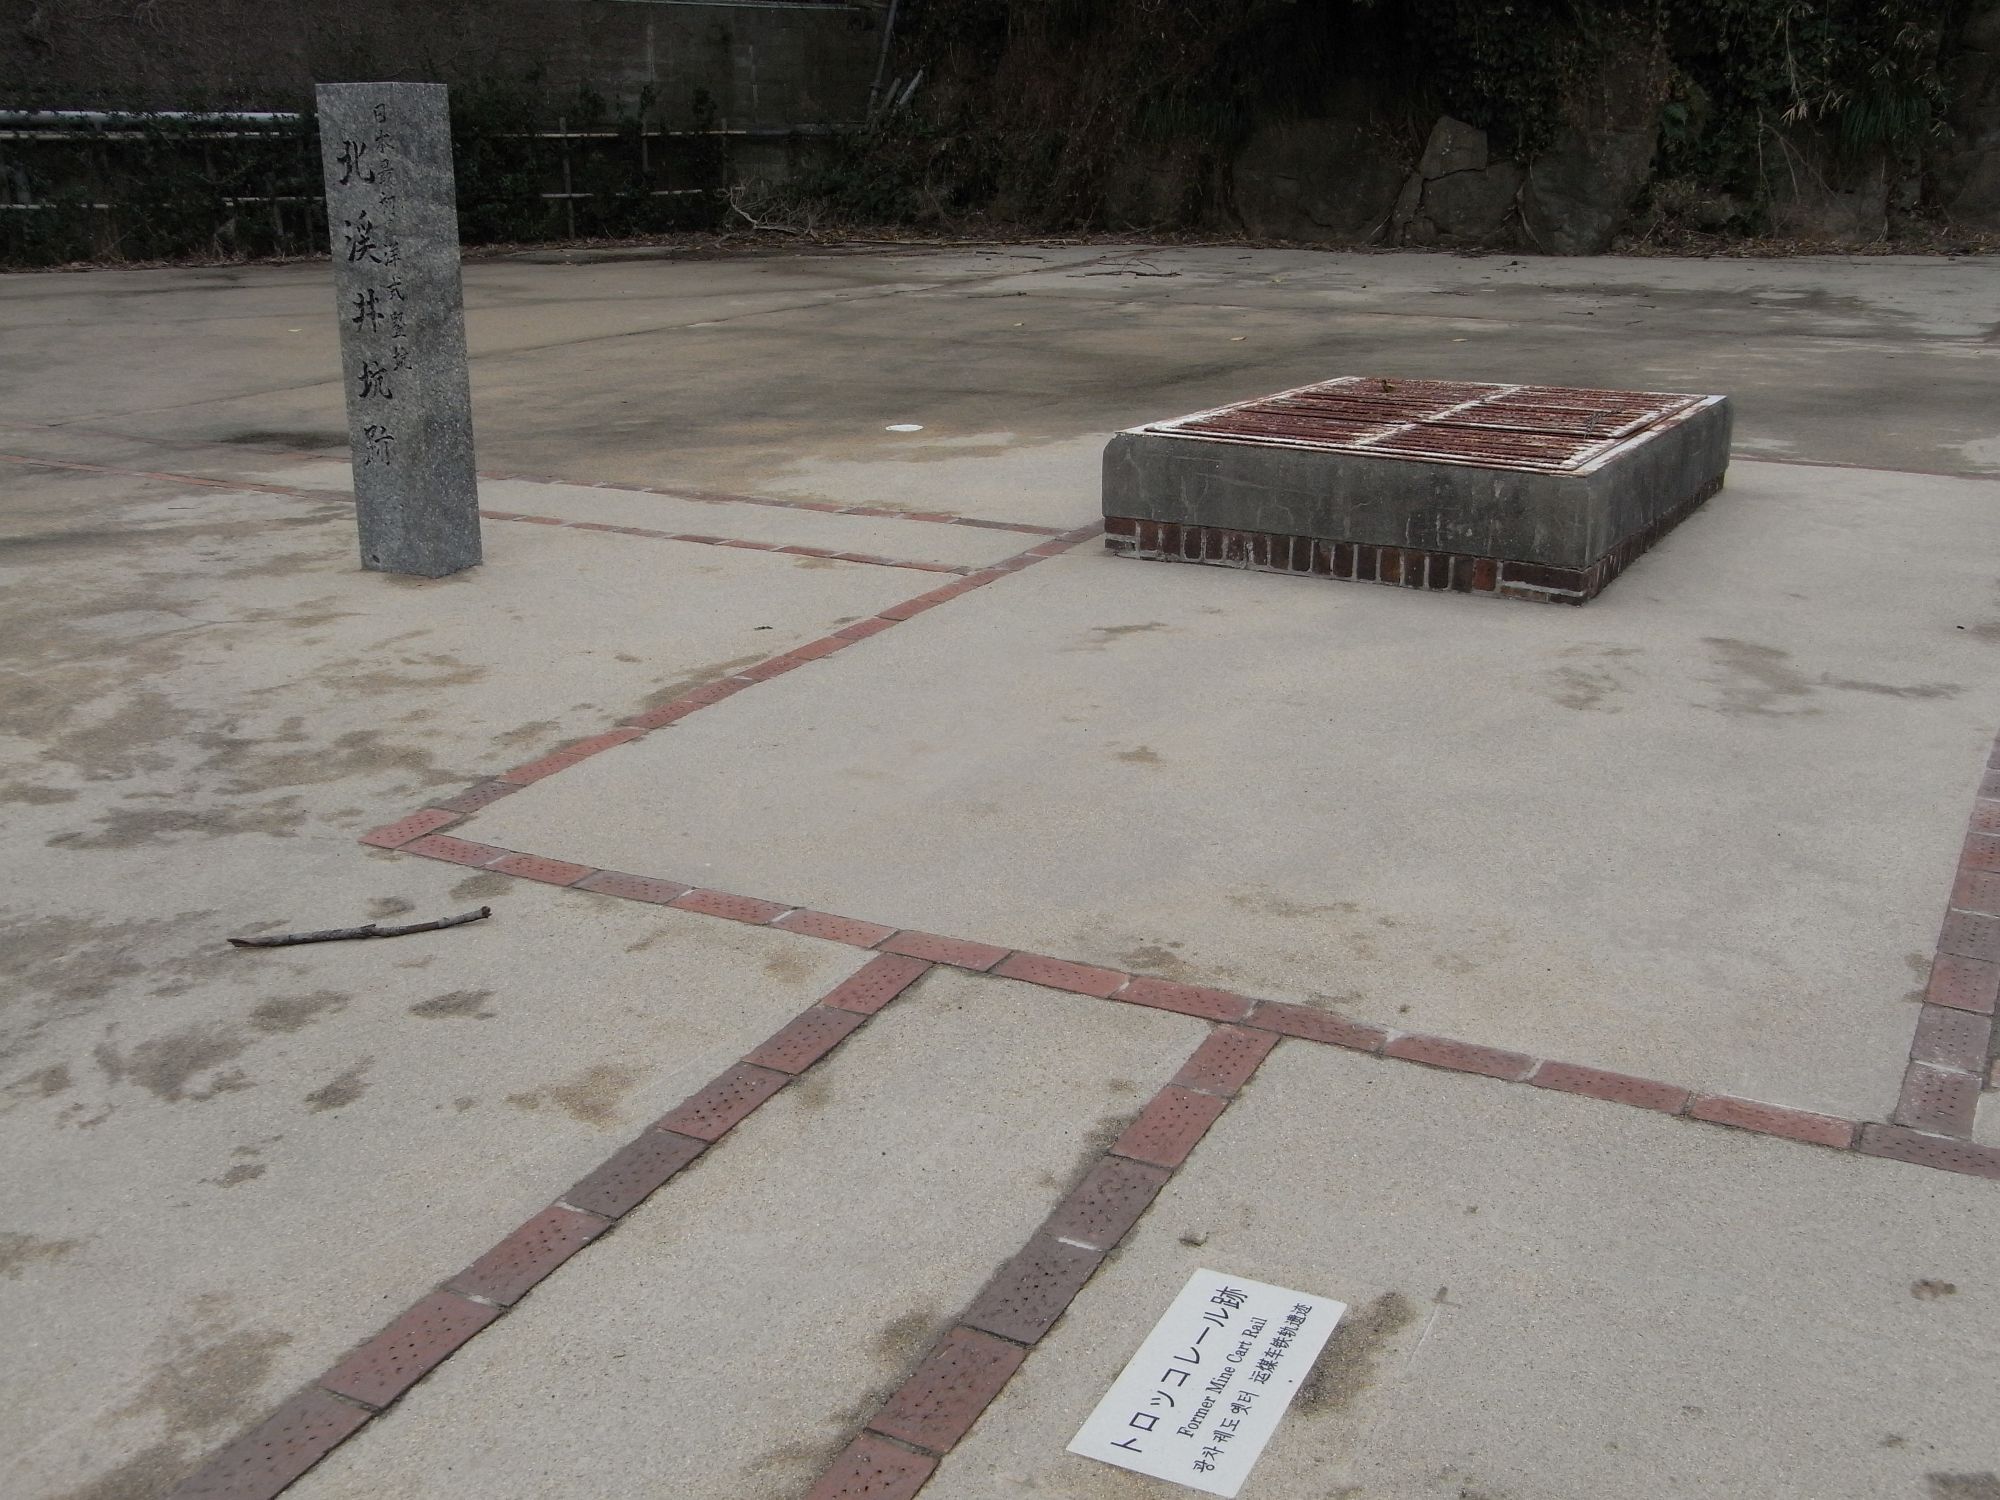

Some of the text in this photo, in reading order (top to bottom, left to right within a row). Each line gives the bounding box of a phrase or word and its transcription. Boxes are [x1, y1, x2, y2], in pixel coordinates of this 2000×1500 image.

[1111, 1286, 1248, 1453] トロッコレール跡
[1177, 1316, 1268, 1439] Former Mine Cart Rail
[1249, 1303, 1313, 1385] 运煤车铁轨遗迹
[1193, 1446, 1225, 1473] 광차
[1231, 1391, 1260, 1416] 옛터
